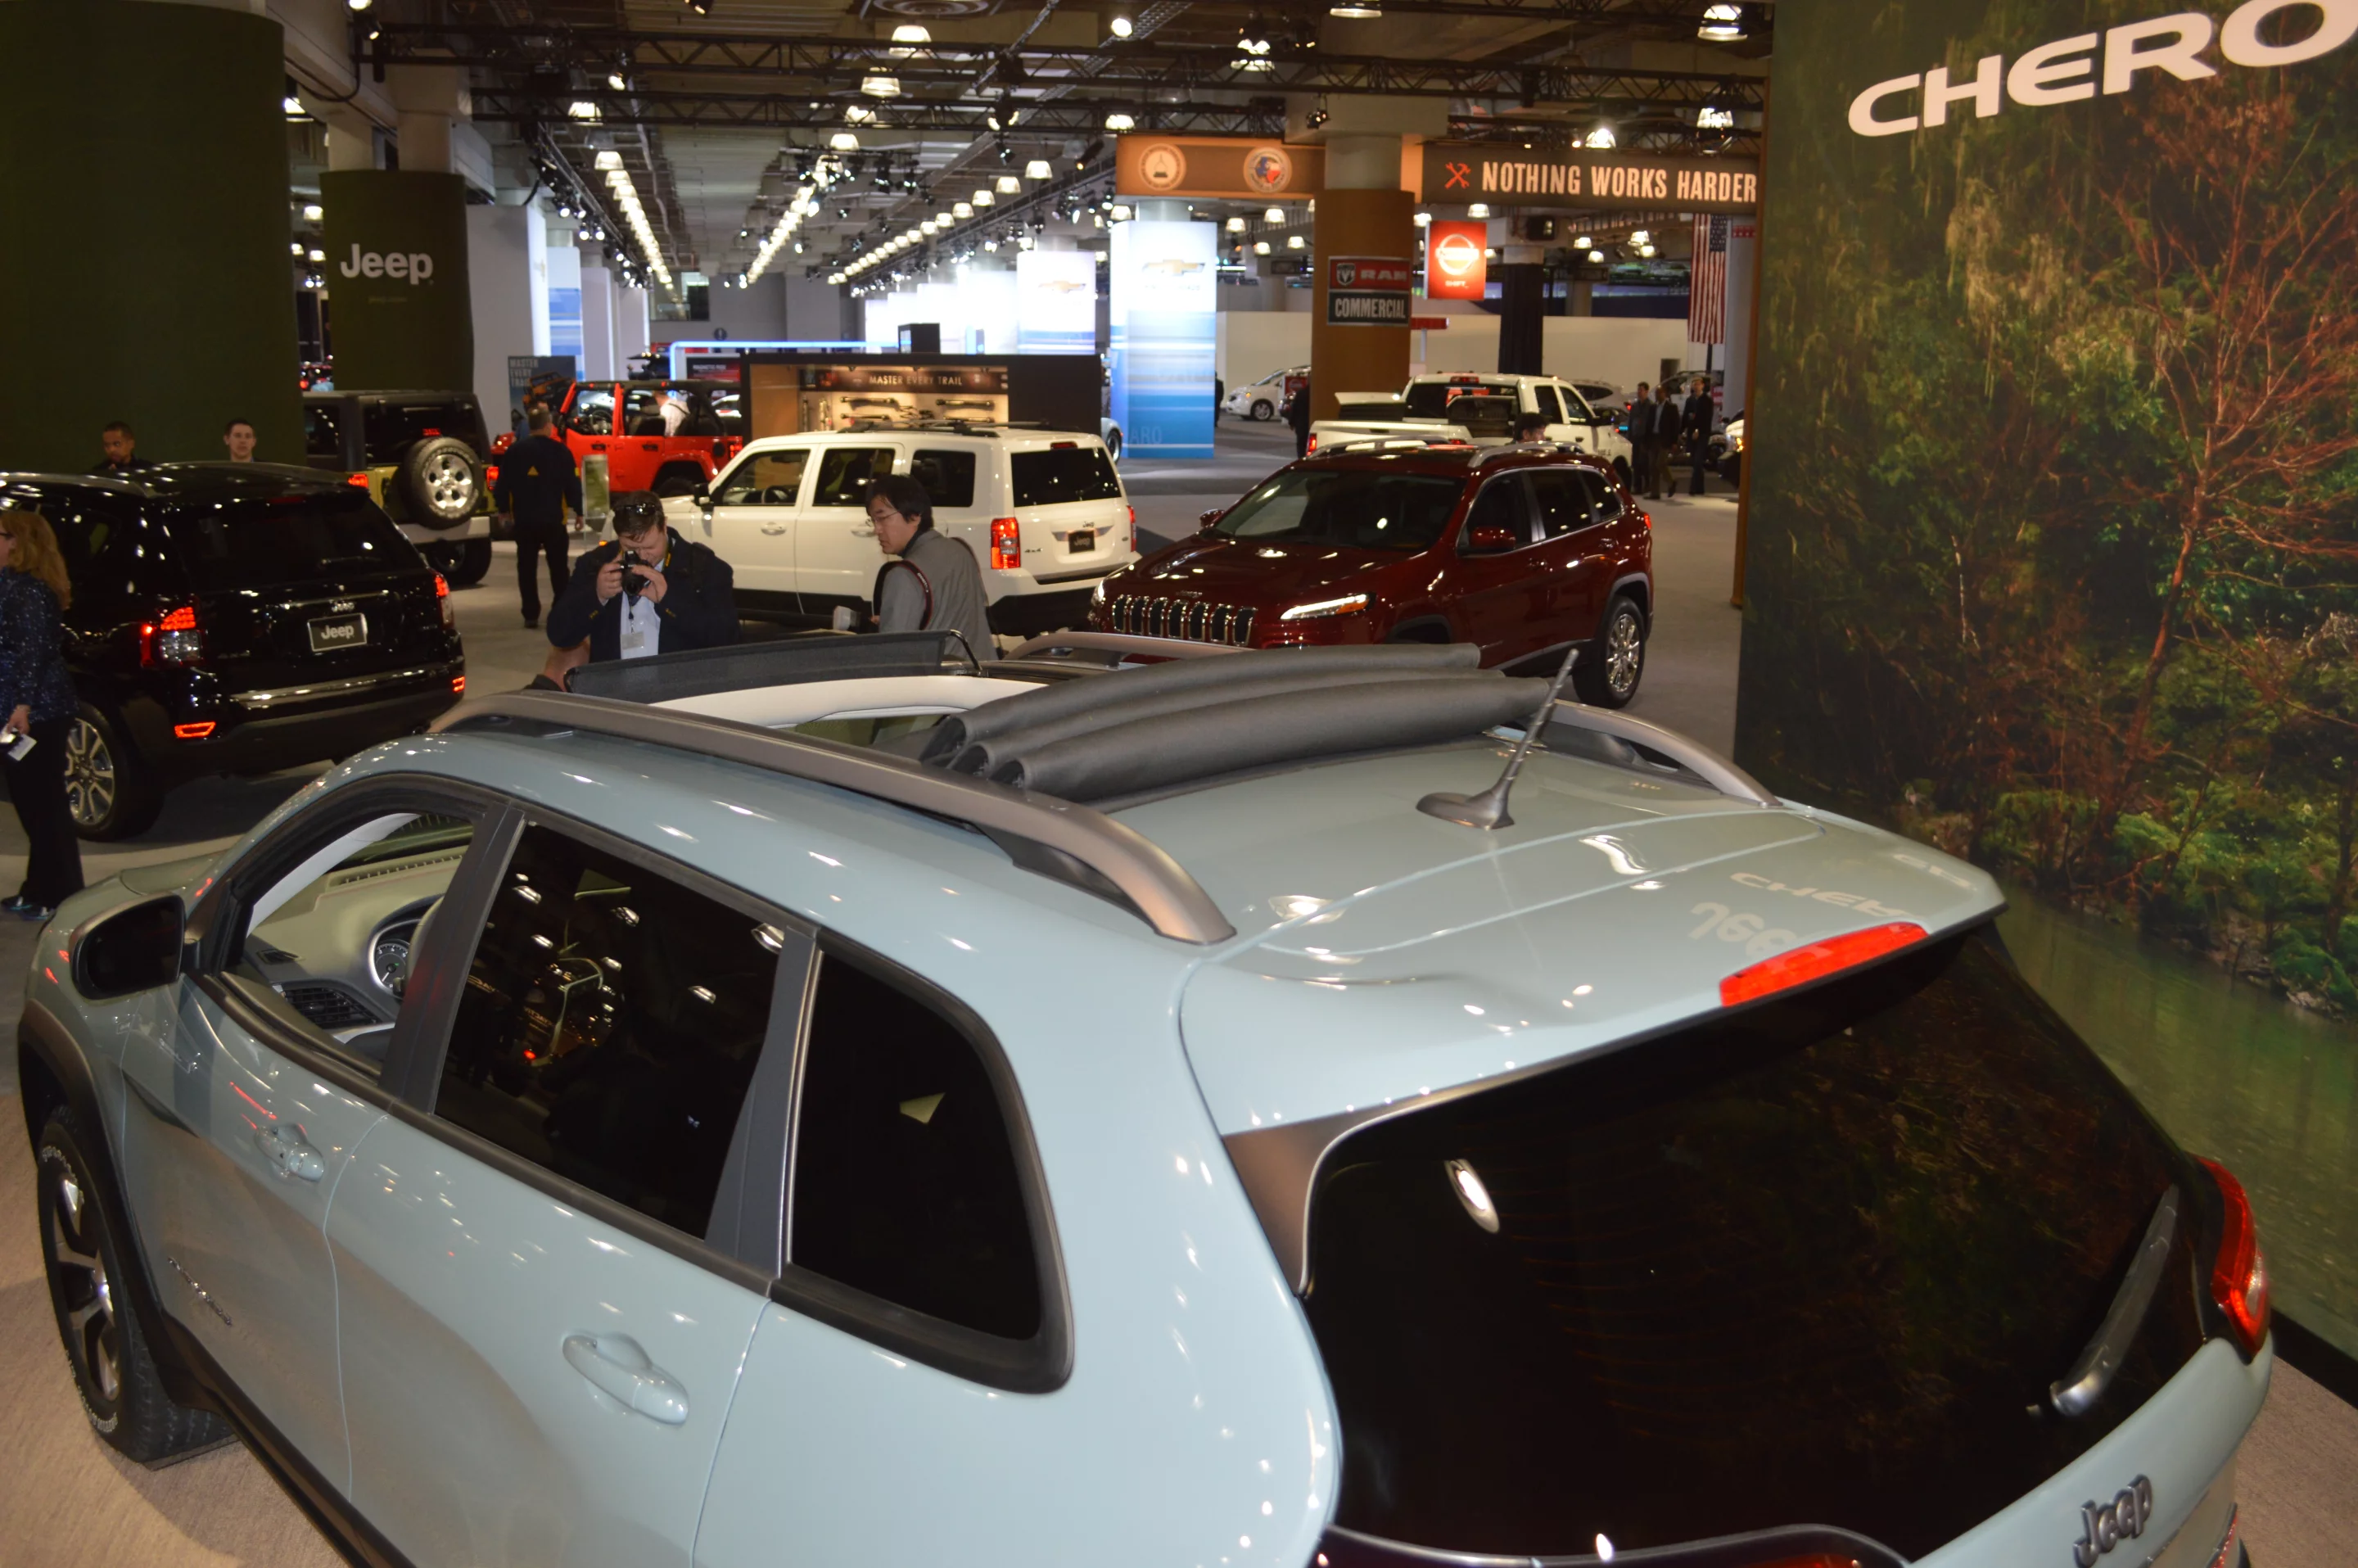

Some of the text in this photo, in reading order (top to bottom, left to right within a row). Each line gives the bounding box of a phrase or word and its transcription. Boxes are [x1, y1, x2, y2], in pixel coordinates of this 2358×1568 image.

[1848, 0, 2358, 137] CHERO
[1482, 161, 1757, 202] NOTHING WORKS HARDER
[340, 242, 434, 286] Jeep
[1360, 269, 1407, 281] RAM
[1335, 297, 1407, 319] COMMERCIAL
[869, 375, 963, 386] MASTER EVERY TRAIL
[320, 625, 355, 639] Jeep
[2072, 1474, 2153, 1568] Jeep
